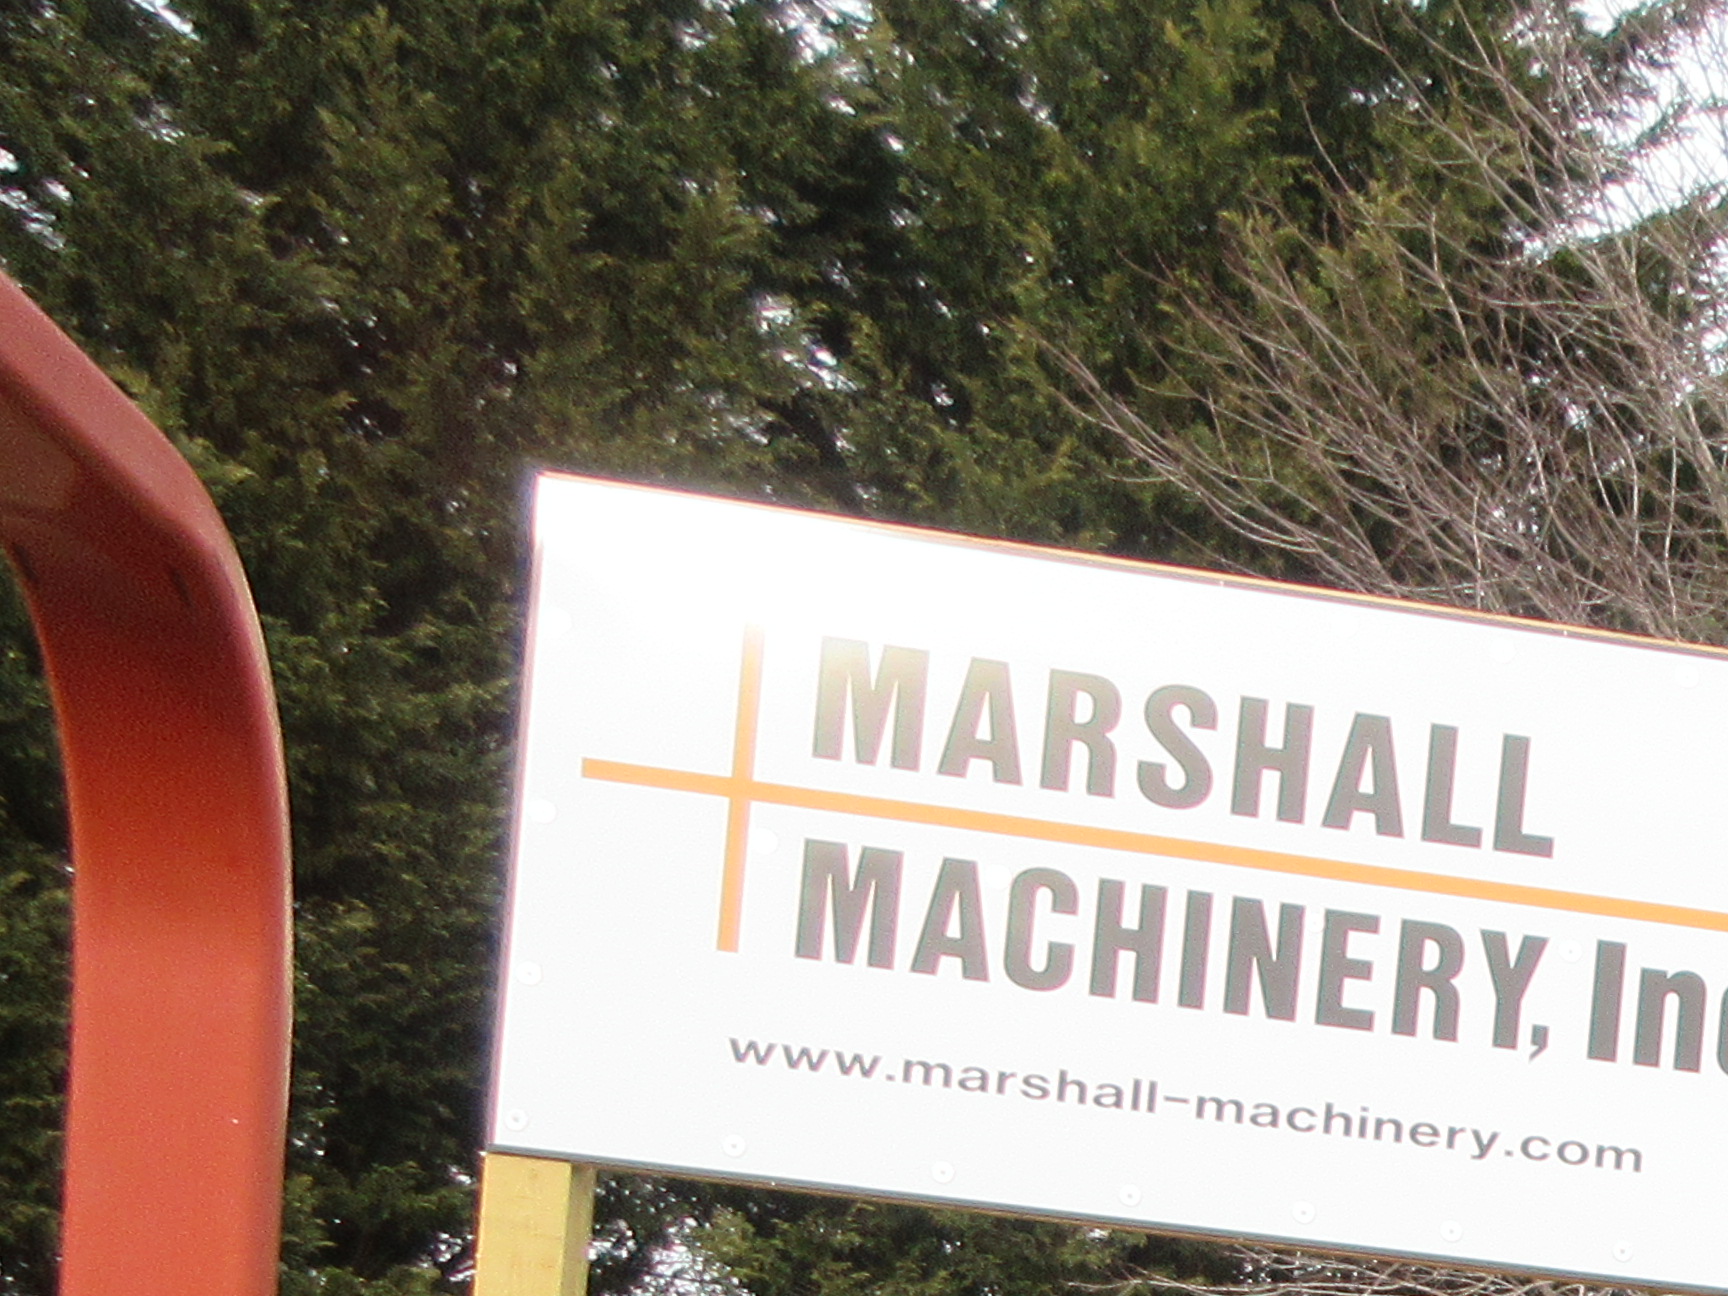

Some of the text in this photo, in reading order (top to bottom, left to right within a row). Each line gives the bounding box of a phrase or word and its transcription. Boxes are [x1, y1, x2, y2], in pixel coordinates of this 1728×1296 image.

[811, 637, 1554, 857] MARSHALL
[795, 838, 1551, 1061] MACHINERY,
[728, 1035, 1645, 1174] www.marshall-machinery.com
